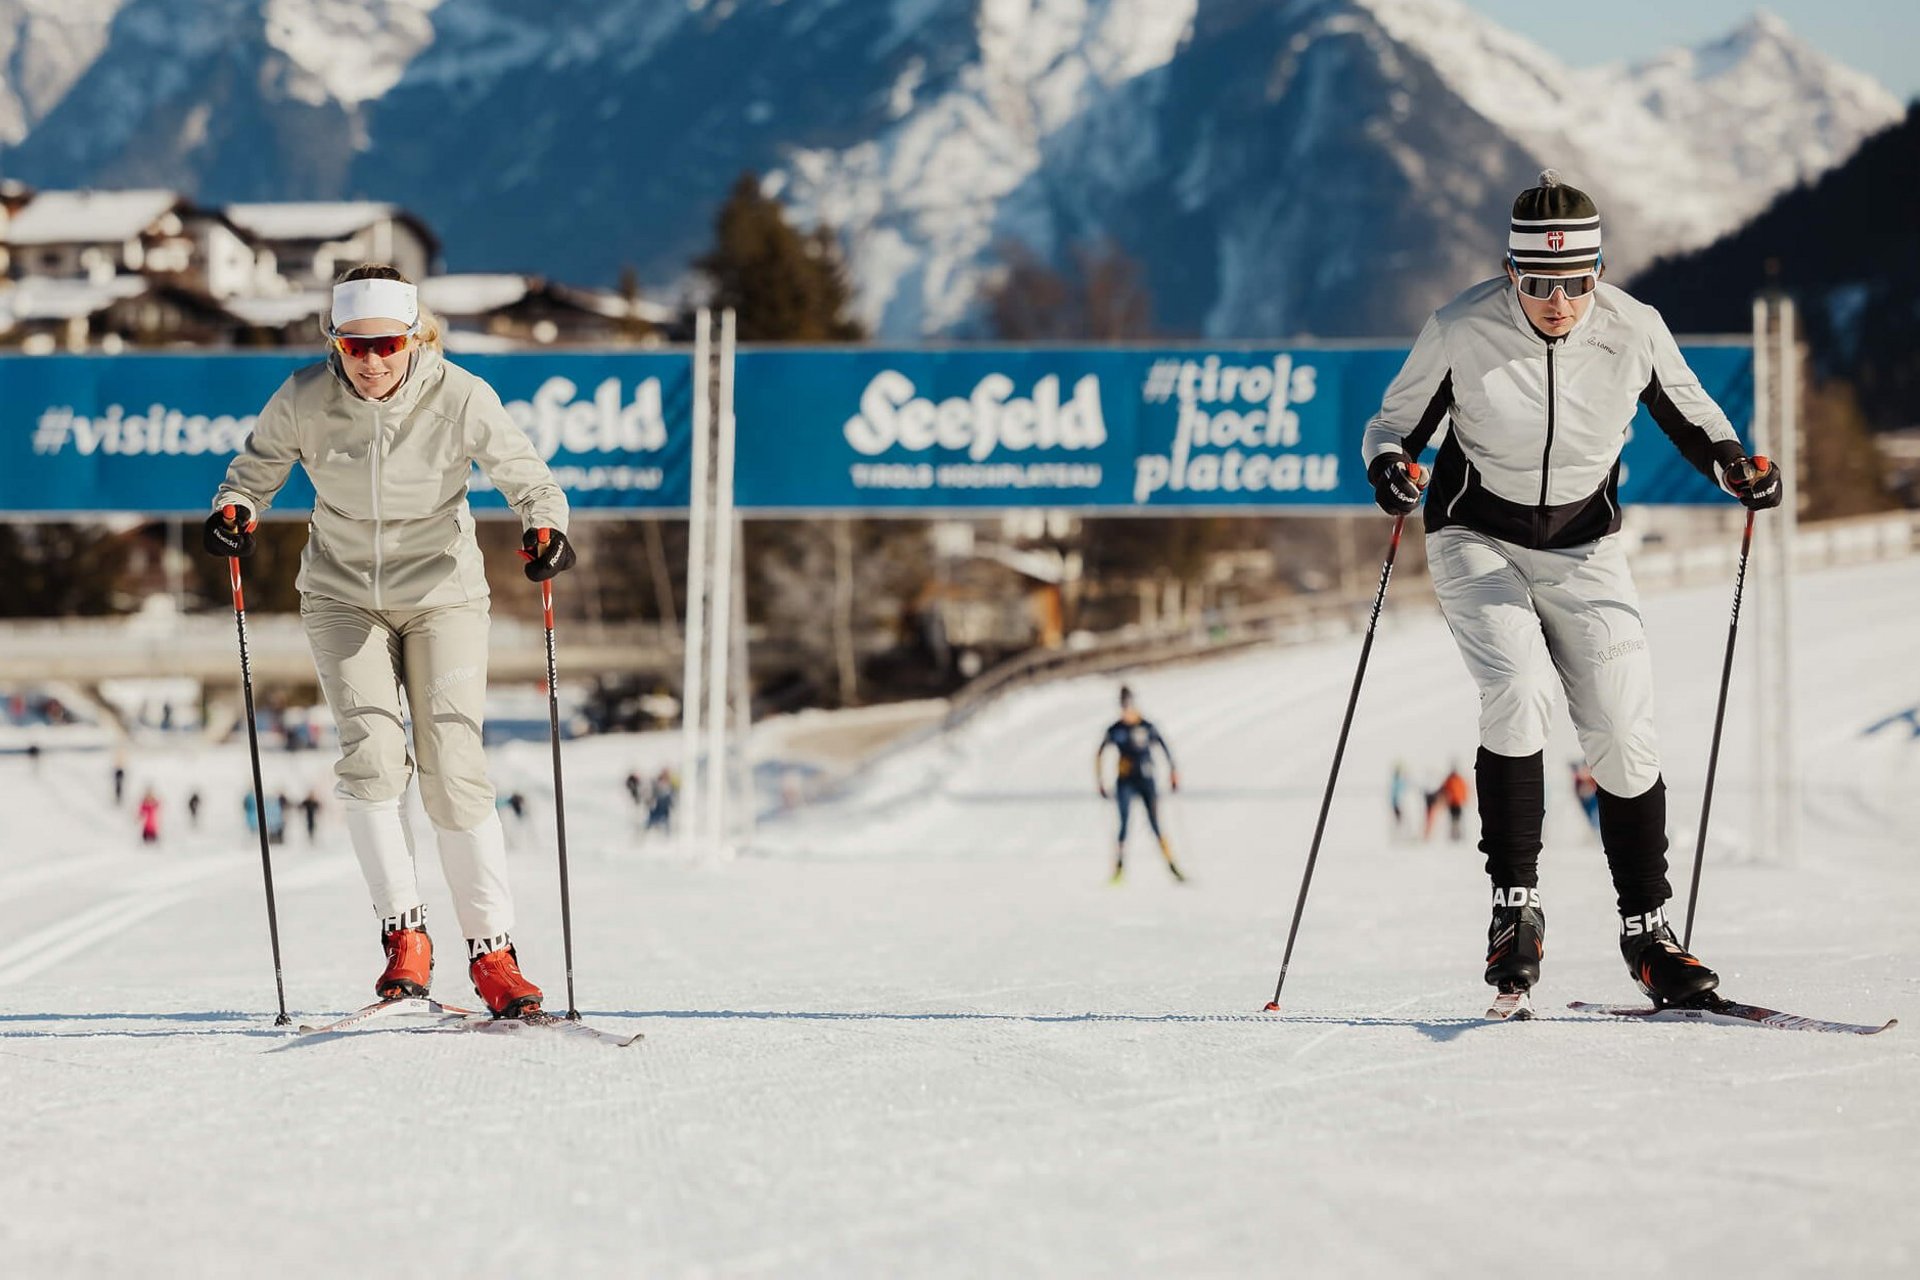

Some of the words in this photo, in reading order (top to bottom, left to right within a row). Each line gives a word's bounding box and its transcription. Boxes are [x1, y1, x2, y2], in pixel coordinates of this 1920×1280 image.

[1142, 354, 1317, 403] #tirols
[843, 369, 1108, 461] Seefeld
[1177, 399, 1300, 447] hoch
[1134, 446, 1339, 504] plateau
